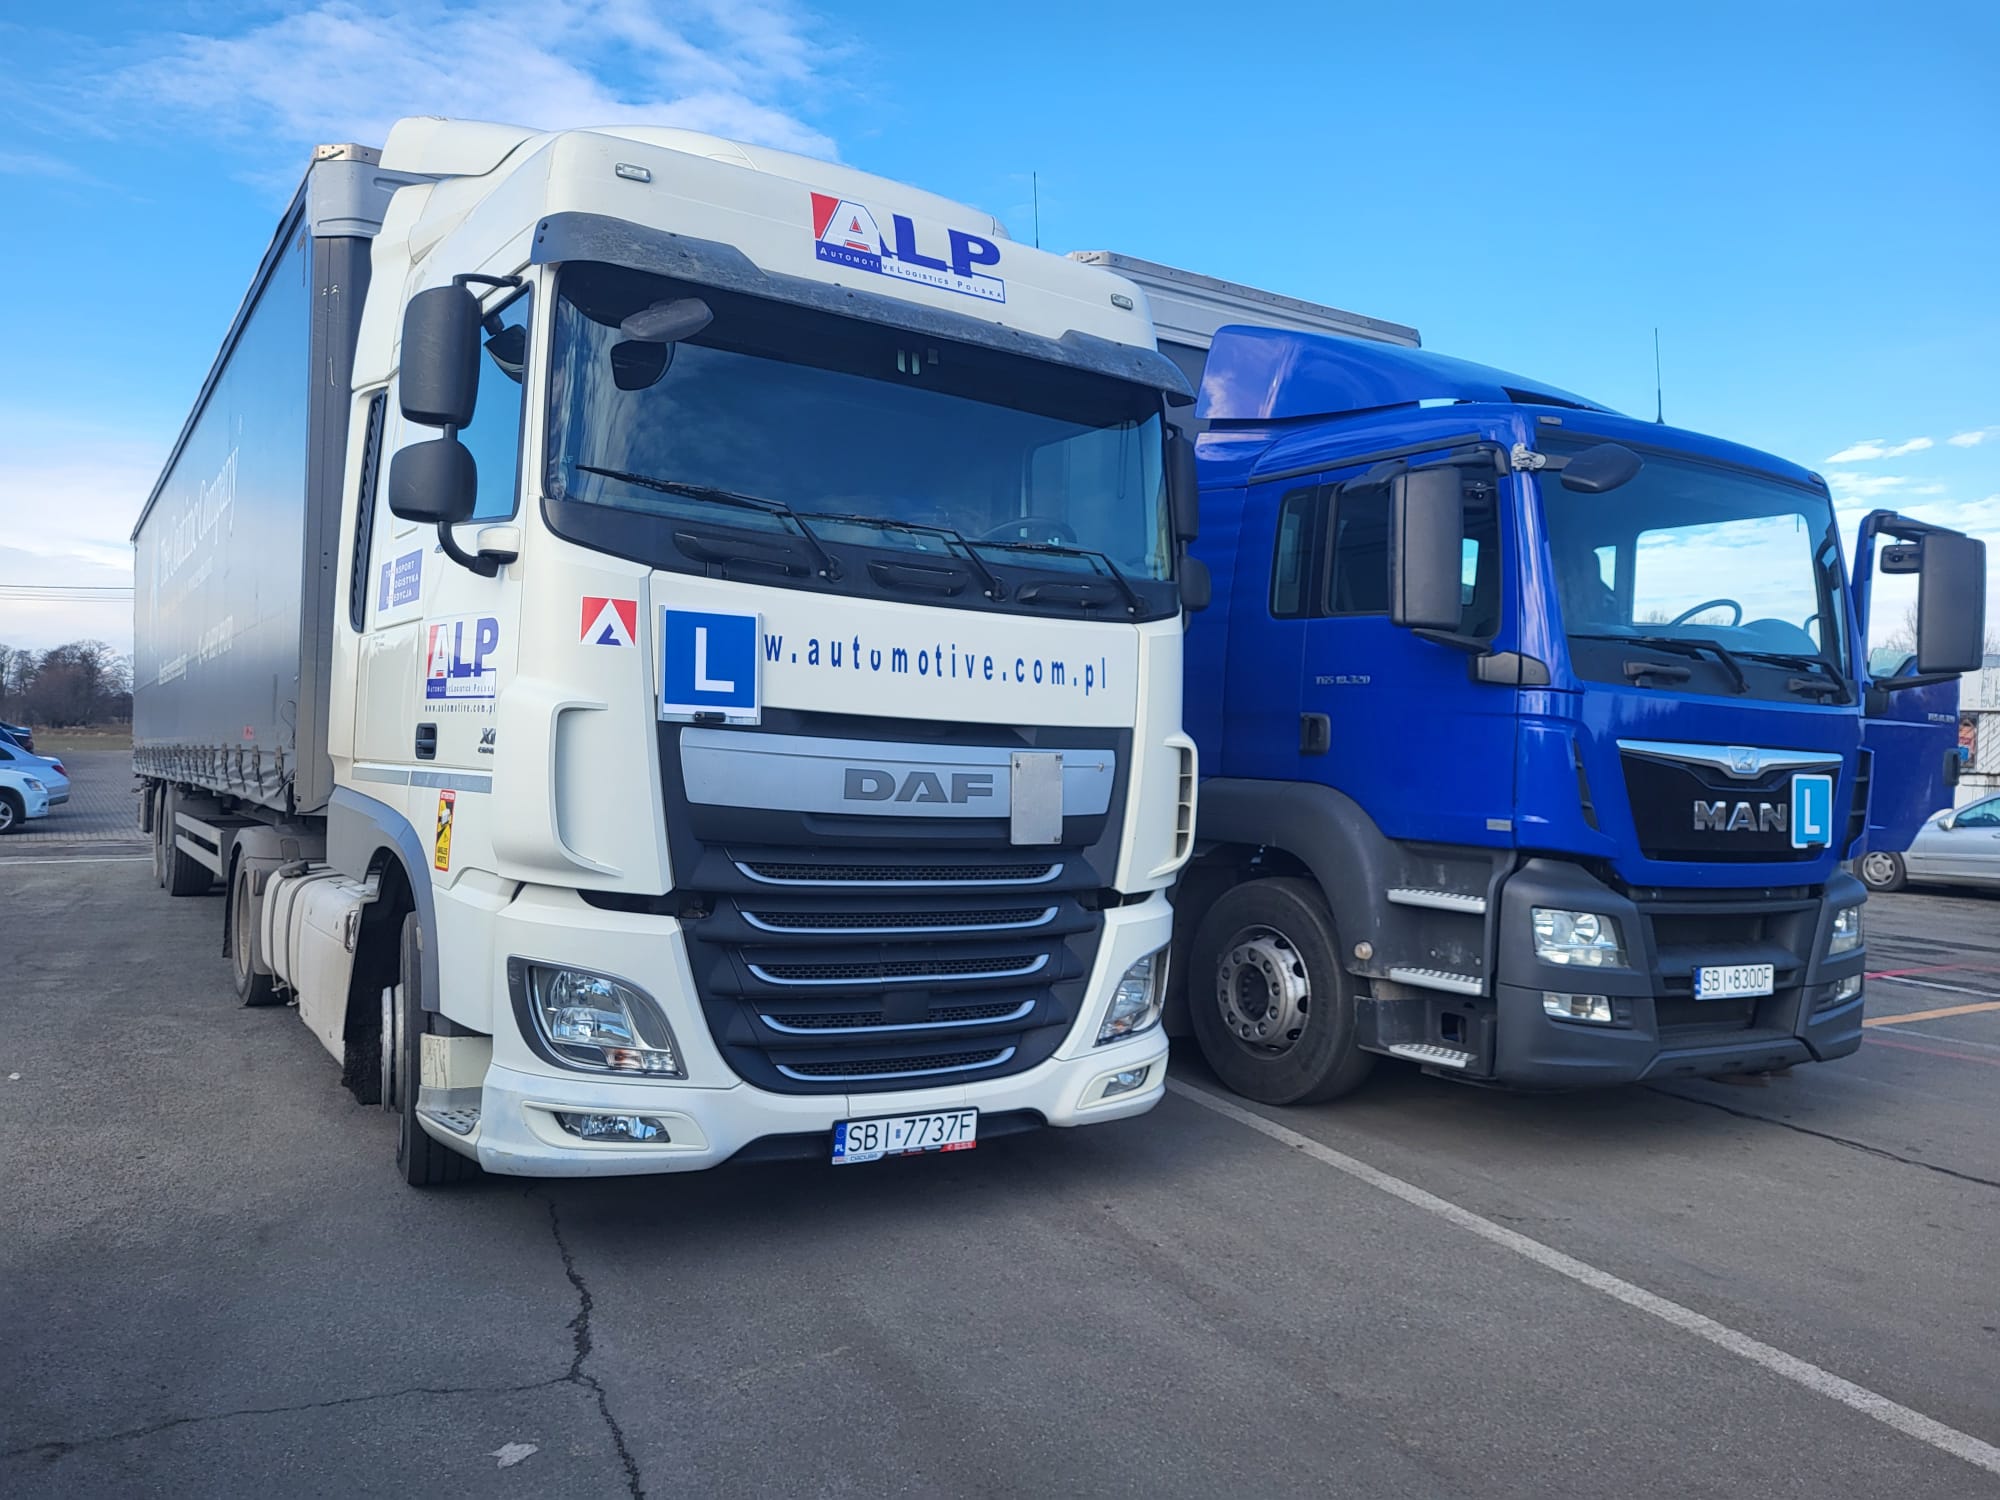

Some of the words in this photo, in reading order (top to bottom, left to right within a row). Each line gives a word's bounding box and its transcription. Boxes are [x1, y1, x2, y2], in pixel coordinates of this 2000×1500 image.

[820, 199, 1001, 278] ALP
[394, 573, 419, 589] OGISTYKA
[427, 617, 499, 678] ALP
[694, 626, 735, 693] L
[843, 767, 994, 804] DAF
[1693, 800, 1788, 832] MAN
[1804, 788, 1820, 834] L
[1703, 969, 1727, 991] SBI
[1733, 967, 1771, 990] 8300F
[848, 1121, 890, 1152] SBI
[903, 1112, 974, 1147] 7737F
